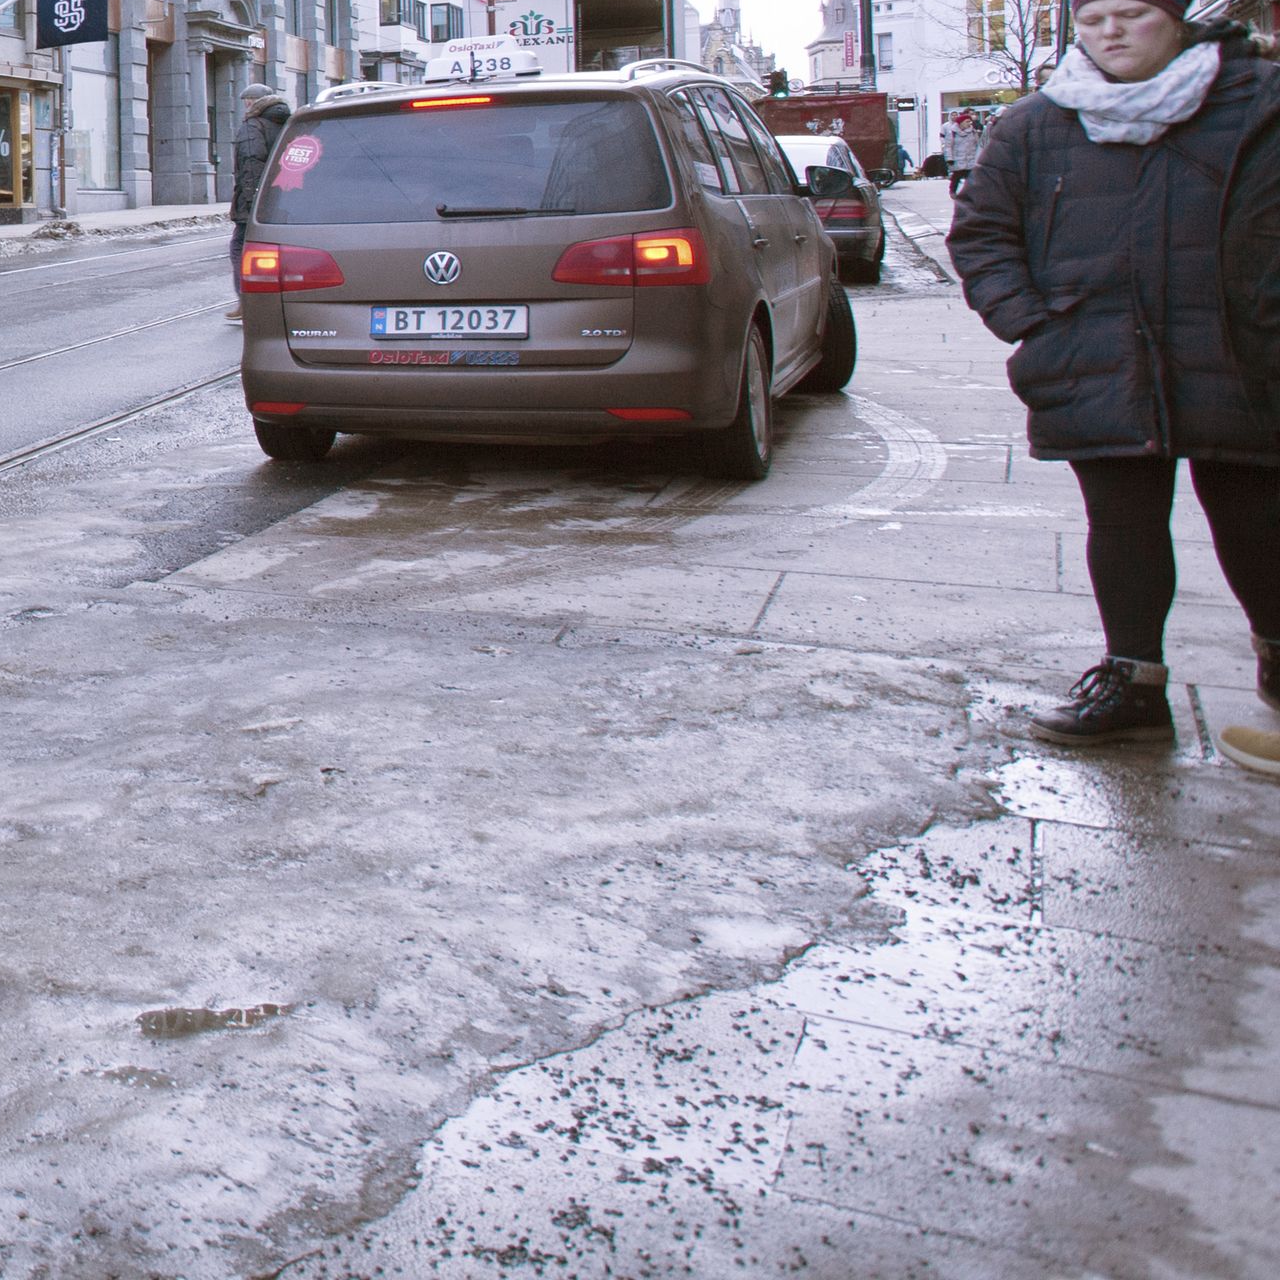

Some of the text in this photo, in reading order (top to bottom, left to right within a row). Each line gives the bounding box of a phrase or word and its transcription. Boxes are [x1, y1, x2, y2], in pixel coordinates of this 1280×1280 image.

[450, 57, 512, 74] A 238
[288, 147, 313, 157] BEST
[394, 309, 517, 331] BT 12037
[368, 350, 450, 365] OsloTaxi
